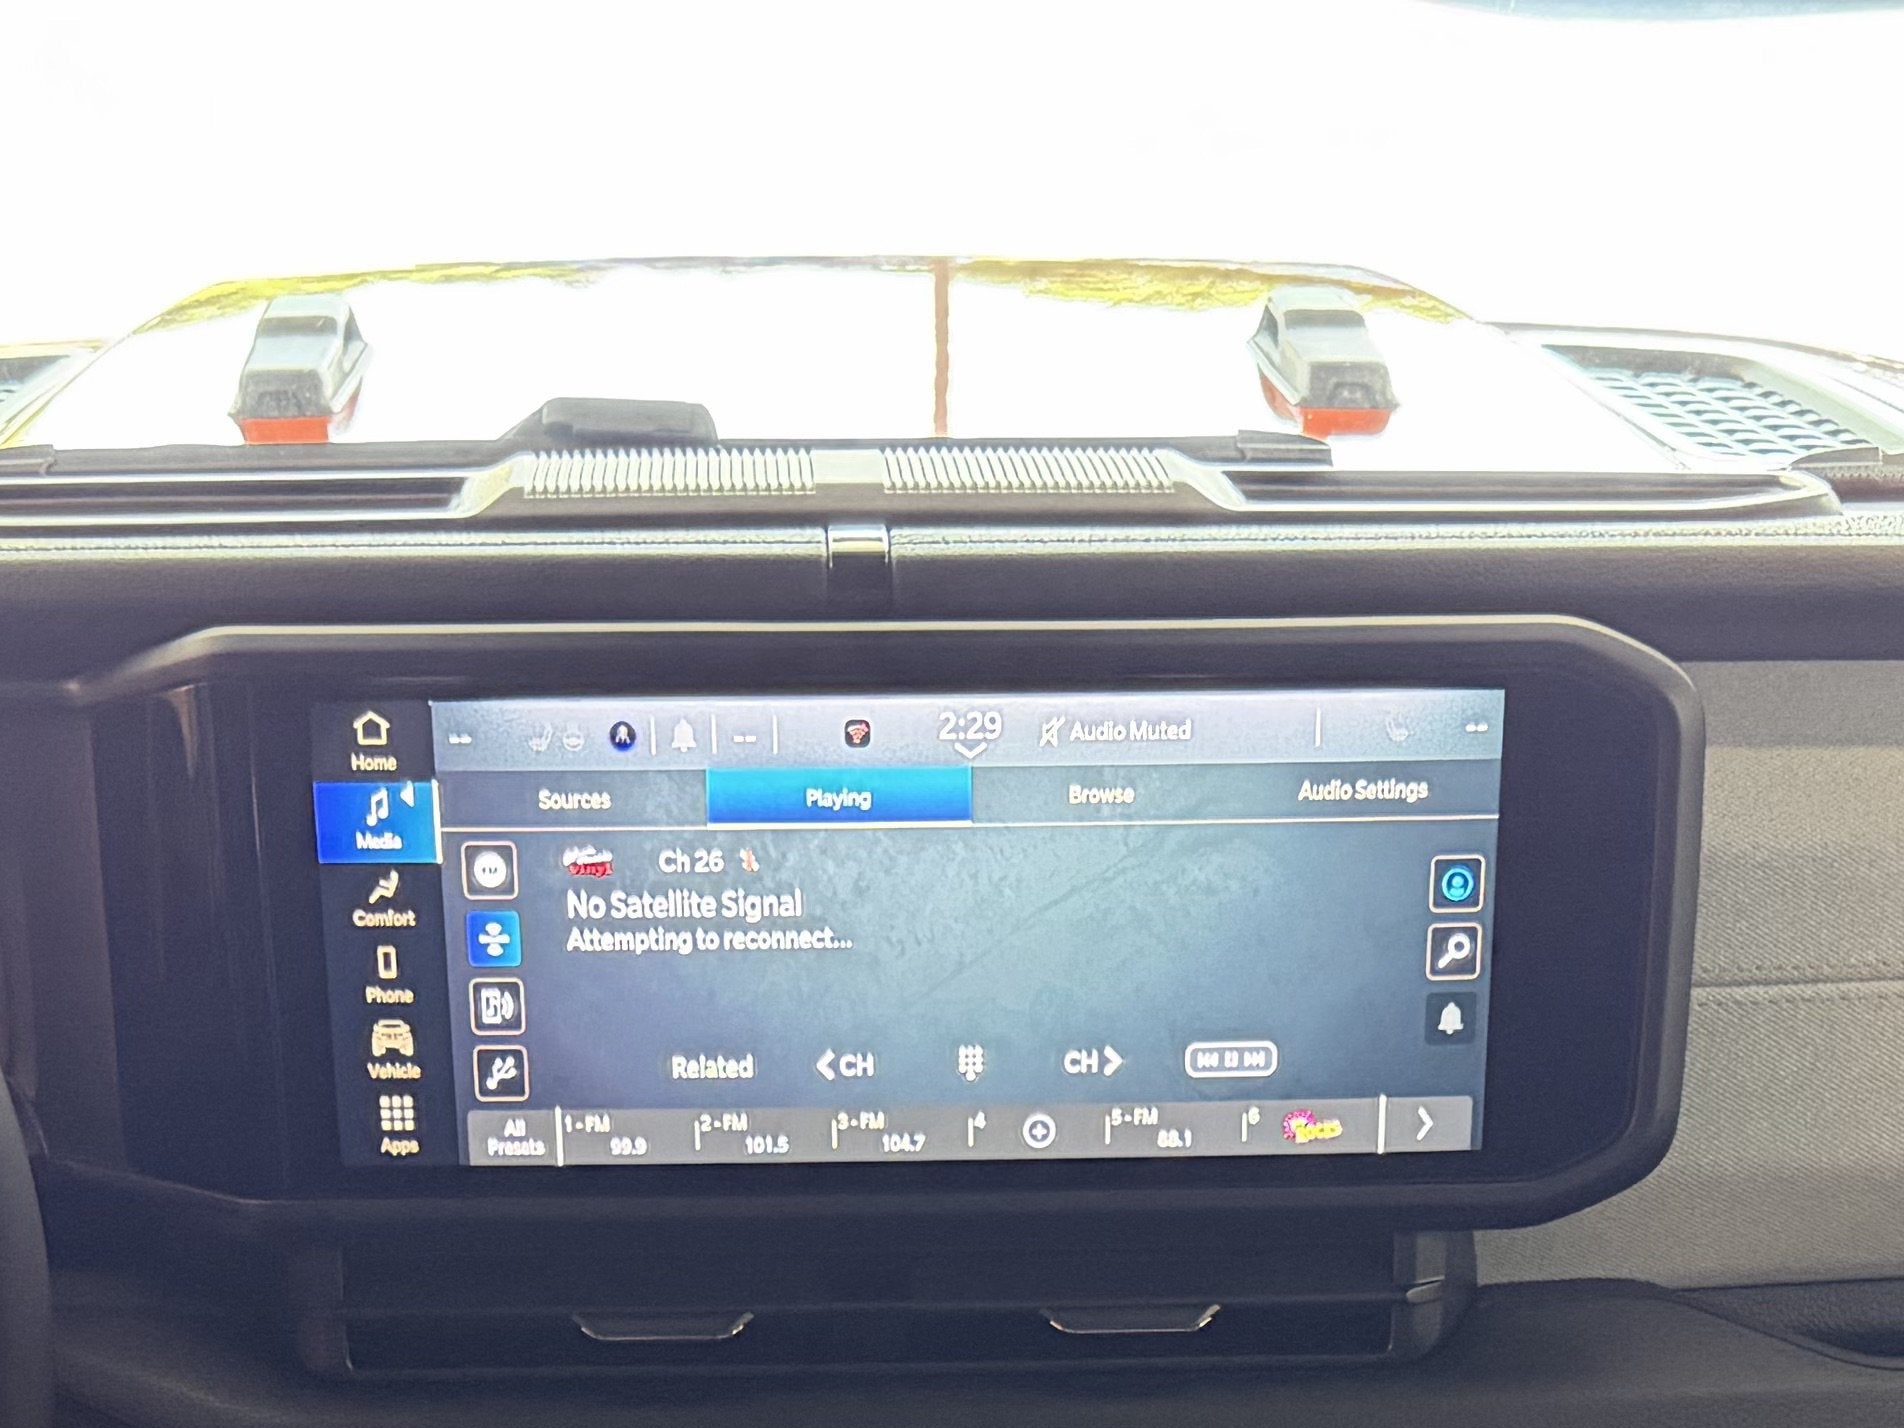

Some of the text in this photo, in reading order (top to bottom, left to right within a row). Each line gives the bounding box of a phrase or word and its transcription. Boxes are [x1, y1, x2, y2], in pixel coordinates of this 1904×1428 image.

[939, 711, 1002, 740] 2:29
[1070, 719, 1192, 742] Audio Muted
[351, 753, 397, 771] Home
[538, 788, 612, 810] Sources
[805, 787, 872, 812] Playing
[1069, 784, 1135, 805] Browse
[1297, 779, 1429, 804] Audio Settings
[356, 831, 403, 850] Media
[659, 847, 725, 873] Ch 26
[567, 886, 803, 923] No Satellite Signal
[352, 909, 416, 928] Comfort
[566, 926, 853, 955] Attempting to reconnect...
[365, 985, 415, 1005] Phone
[367, 1062, 422, 1080] Vehicle
[672, 1053, 754, 1080] Related
[839, 1054, 874, 1077] CH
[1063, 1049, 1099, 1074] CH
[503, 1119, 526, 1137] All
[380, 1137, 420, 1156] Apps
[486, 1137, 546, 1156] Presets
[744, 1135, 790, 1154] 101.5
[881, 1133, 926, 1153] 104.7
